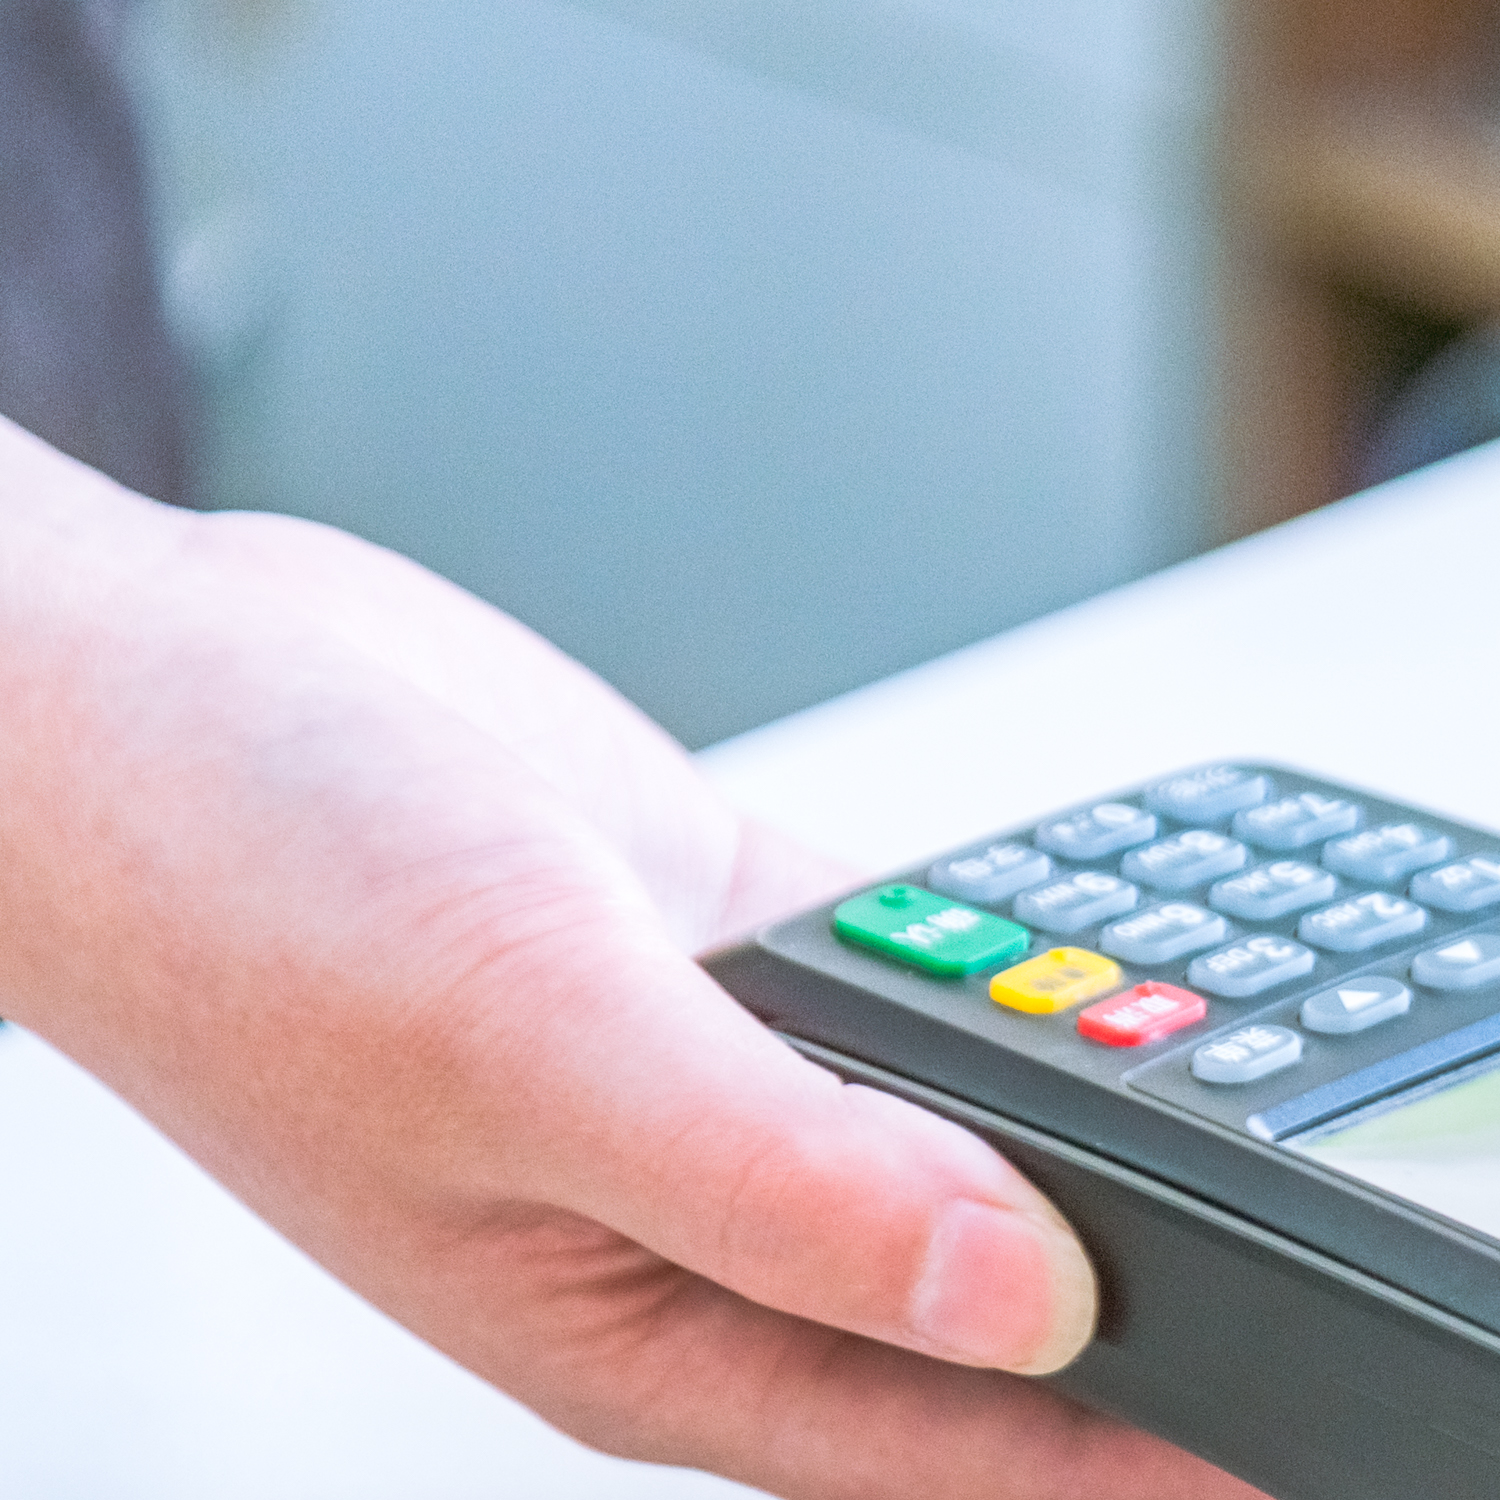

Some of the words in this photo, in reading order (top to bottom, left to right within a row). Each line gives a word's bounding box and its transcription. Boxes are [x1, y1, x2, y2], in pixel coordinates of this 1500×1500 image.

[1301, 792, 1342, 815] 7
[1178, 829, 1226, 850] 8
[1072, 871, 1118, 892] 9
[1268, 860, 1314, 884] 5
[1159, 903, 1205, 925] 6
[1356, 891, 1407, 915] 2
[1246, 936, 1293, 958] 3
[1205, 948, 1254, 973] DEF
